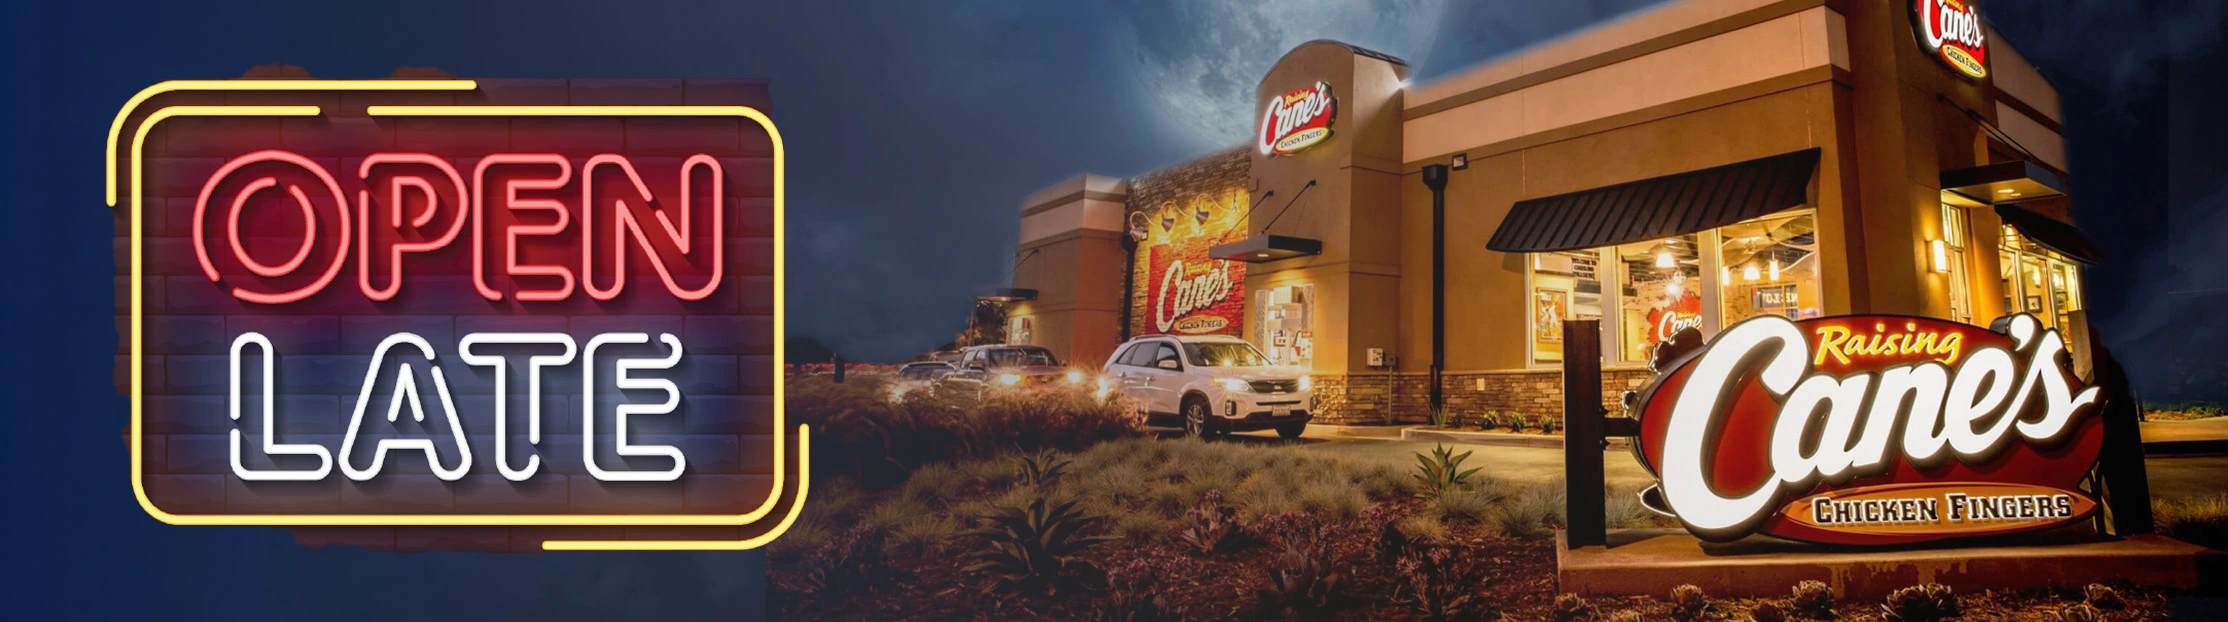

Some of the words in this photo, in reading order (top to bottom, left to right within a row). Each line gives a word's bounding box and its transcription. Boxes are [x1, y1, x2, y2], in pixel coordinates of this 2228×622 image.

[1924, 0, 1984, 48] Cane's
[1259, 81, 1330, 155] Cane's
[1284, 89, 1309, 107] Raising
[1156, 259, 1234, 333] Cane's
[1814, 323, 1964, 365] Raising
[1661, 313, 2101, 529] Cane's
[1812, 496, 1938, 526] CHICKEN
[1947, 492, 2073, 524] FINGERS
